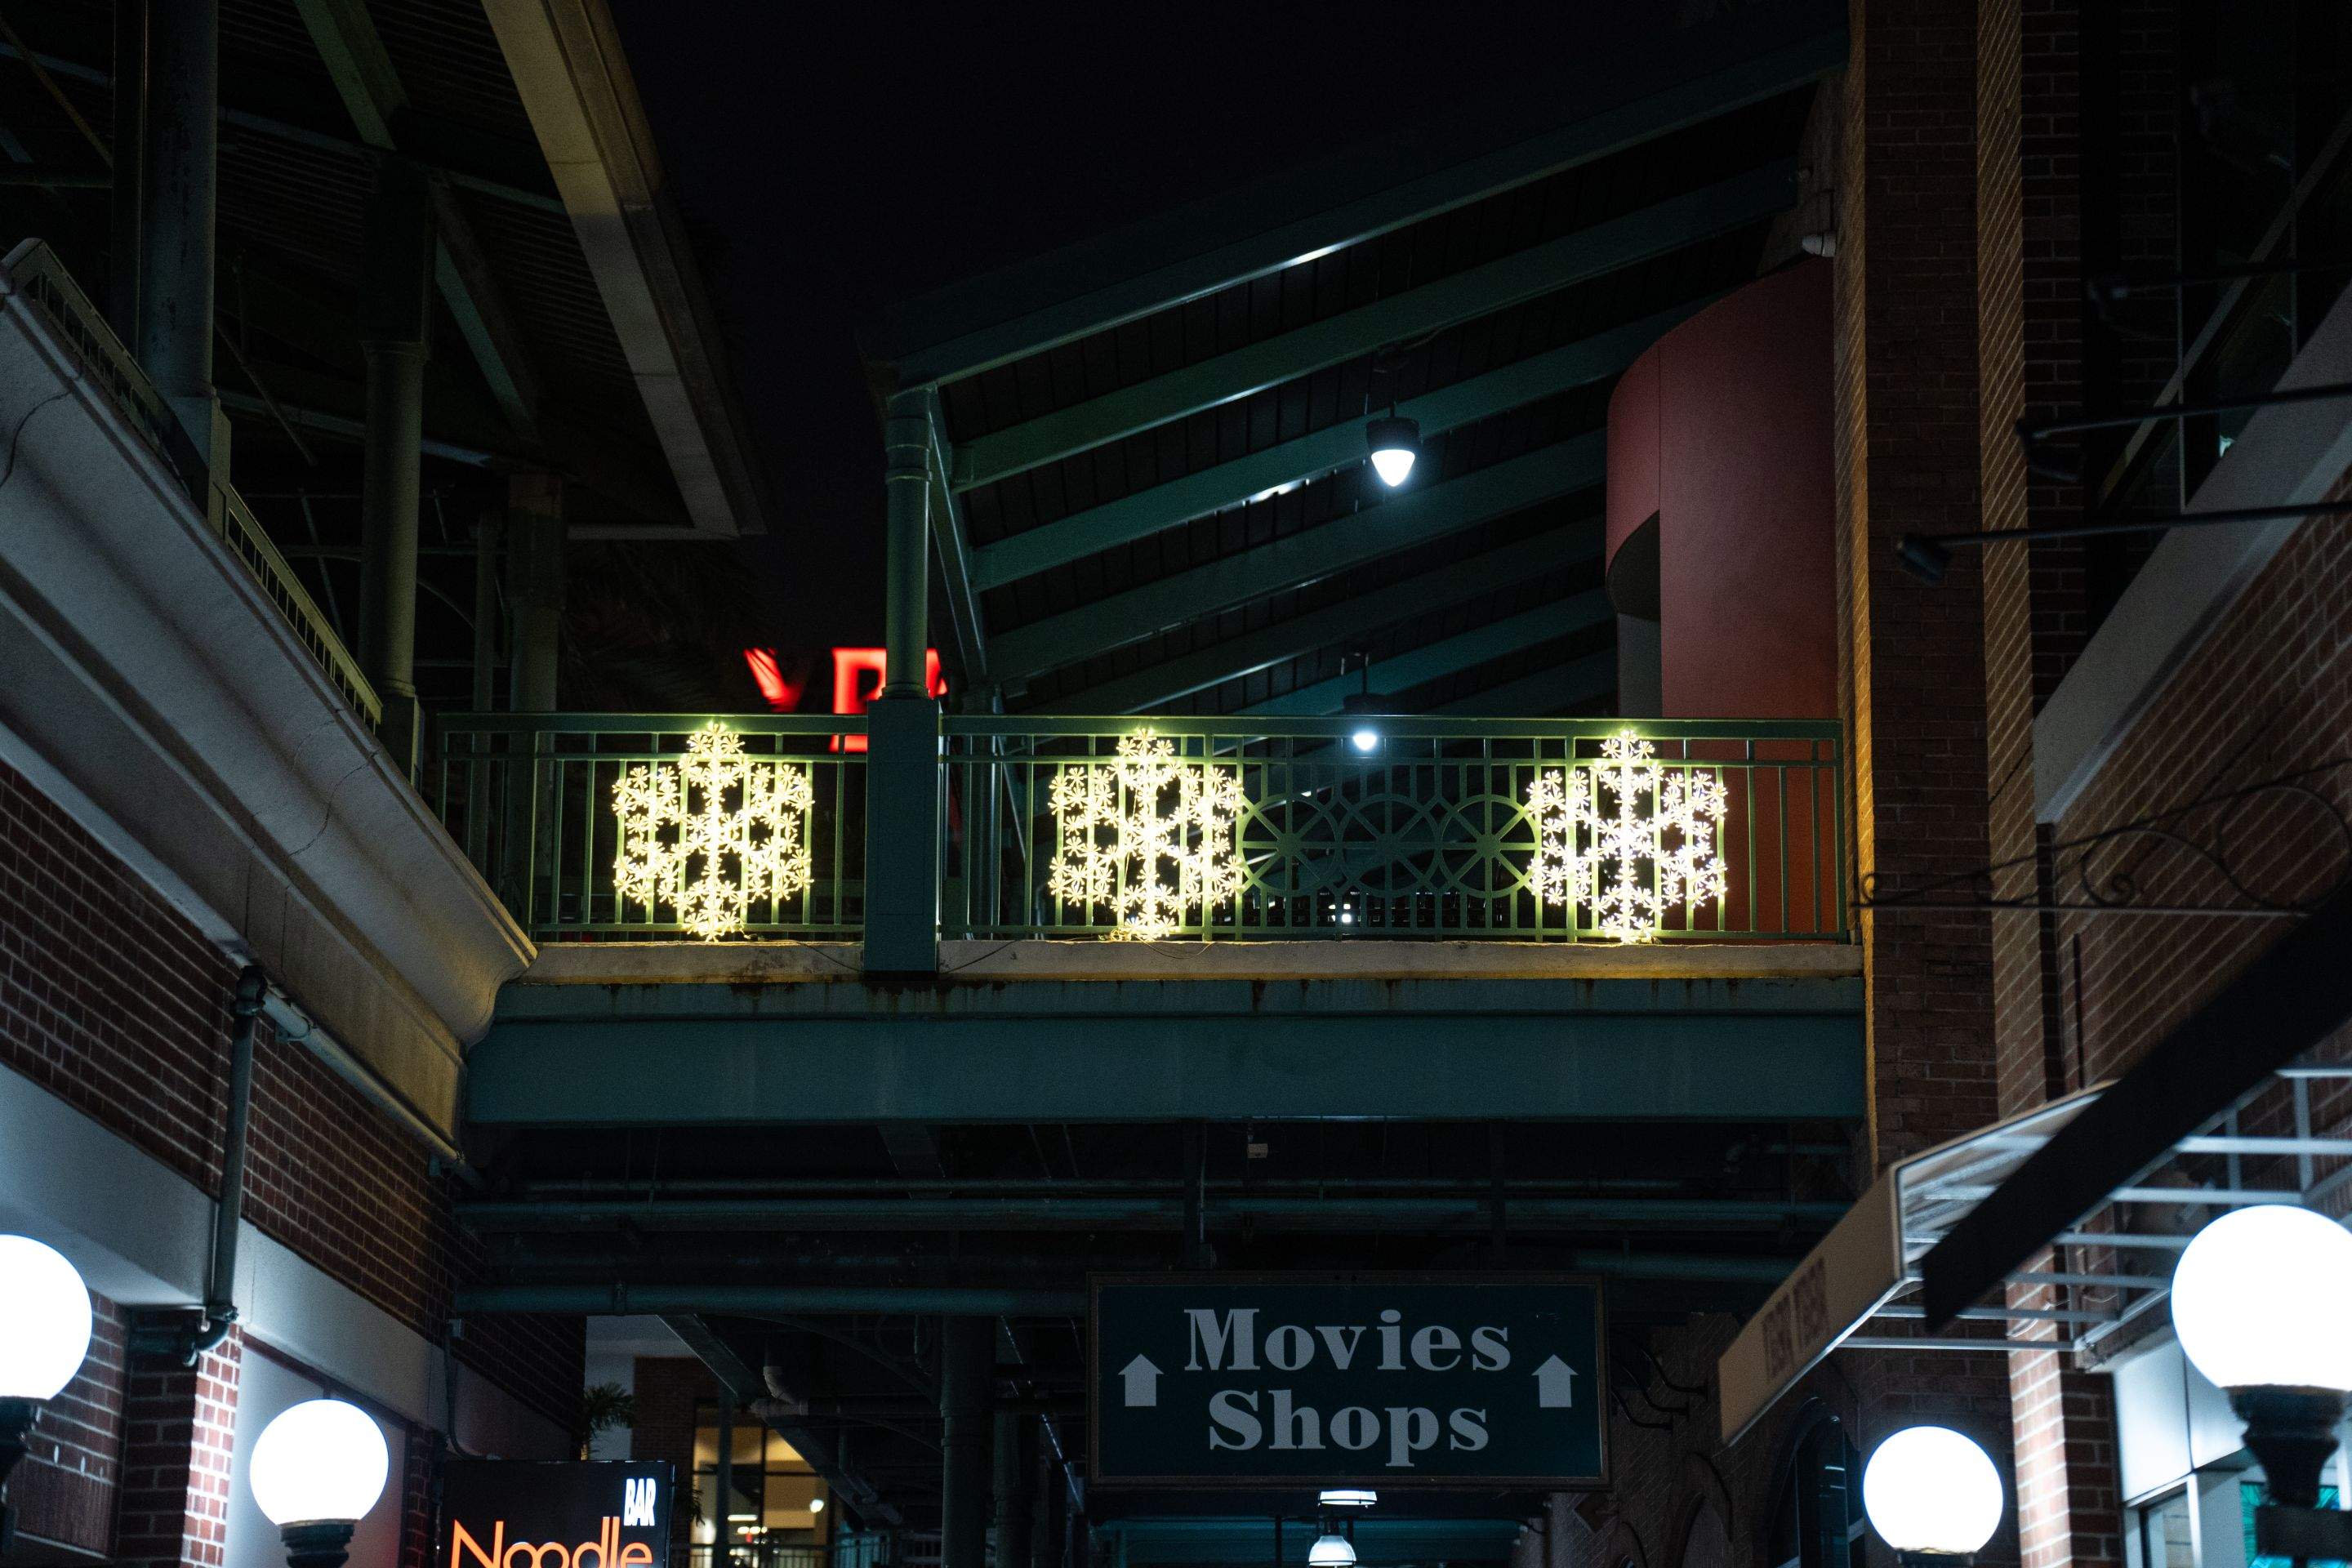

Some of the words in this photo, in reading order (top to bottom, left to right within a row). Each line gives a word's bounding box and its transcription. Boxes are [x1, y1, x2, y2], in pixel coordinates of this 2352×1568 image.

[1184, 1308, 1511, 1371] Movies
[1209, 1388, 1489, 1468] Shops
[623, 1477, 656, 1526] BAR
[450, 1516, 653, 1568] Noodle
